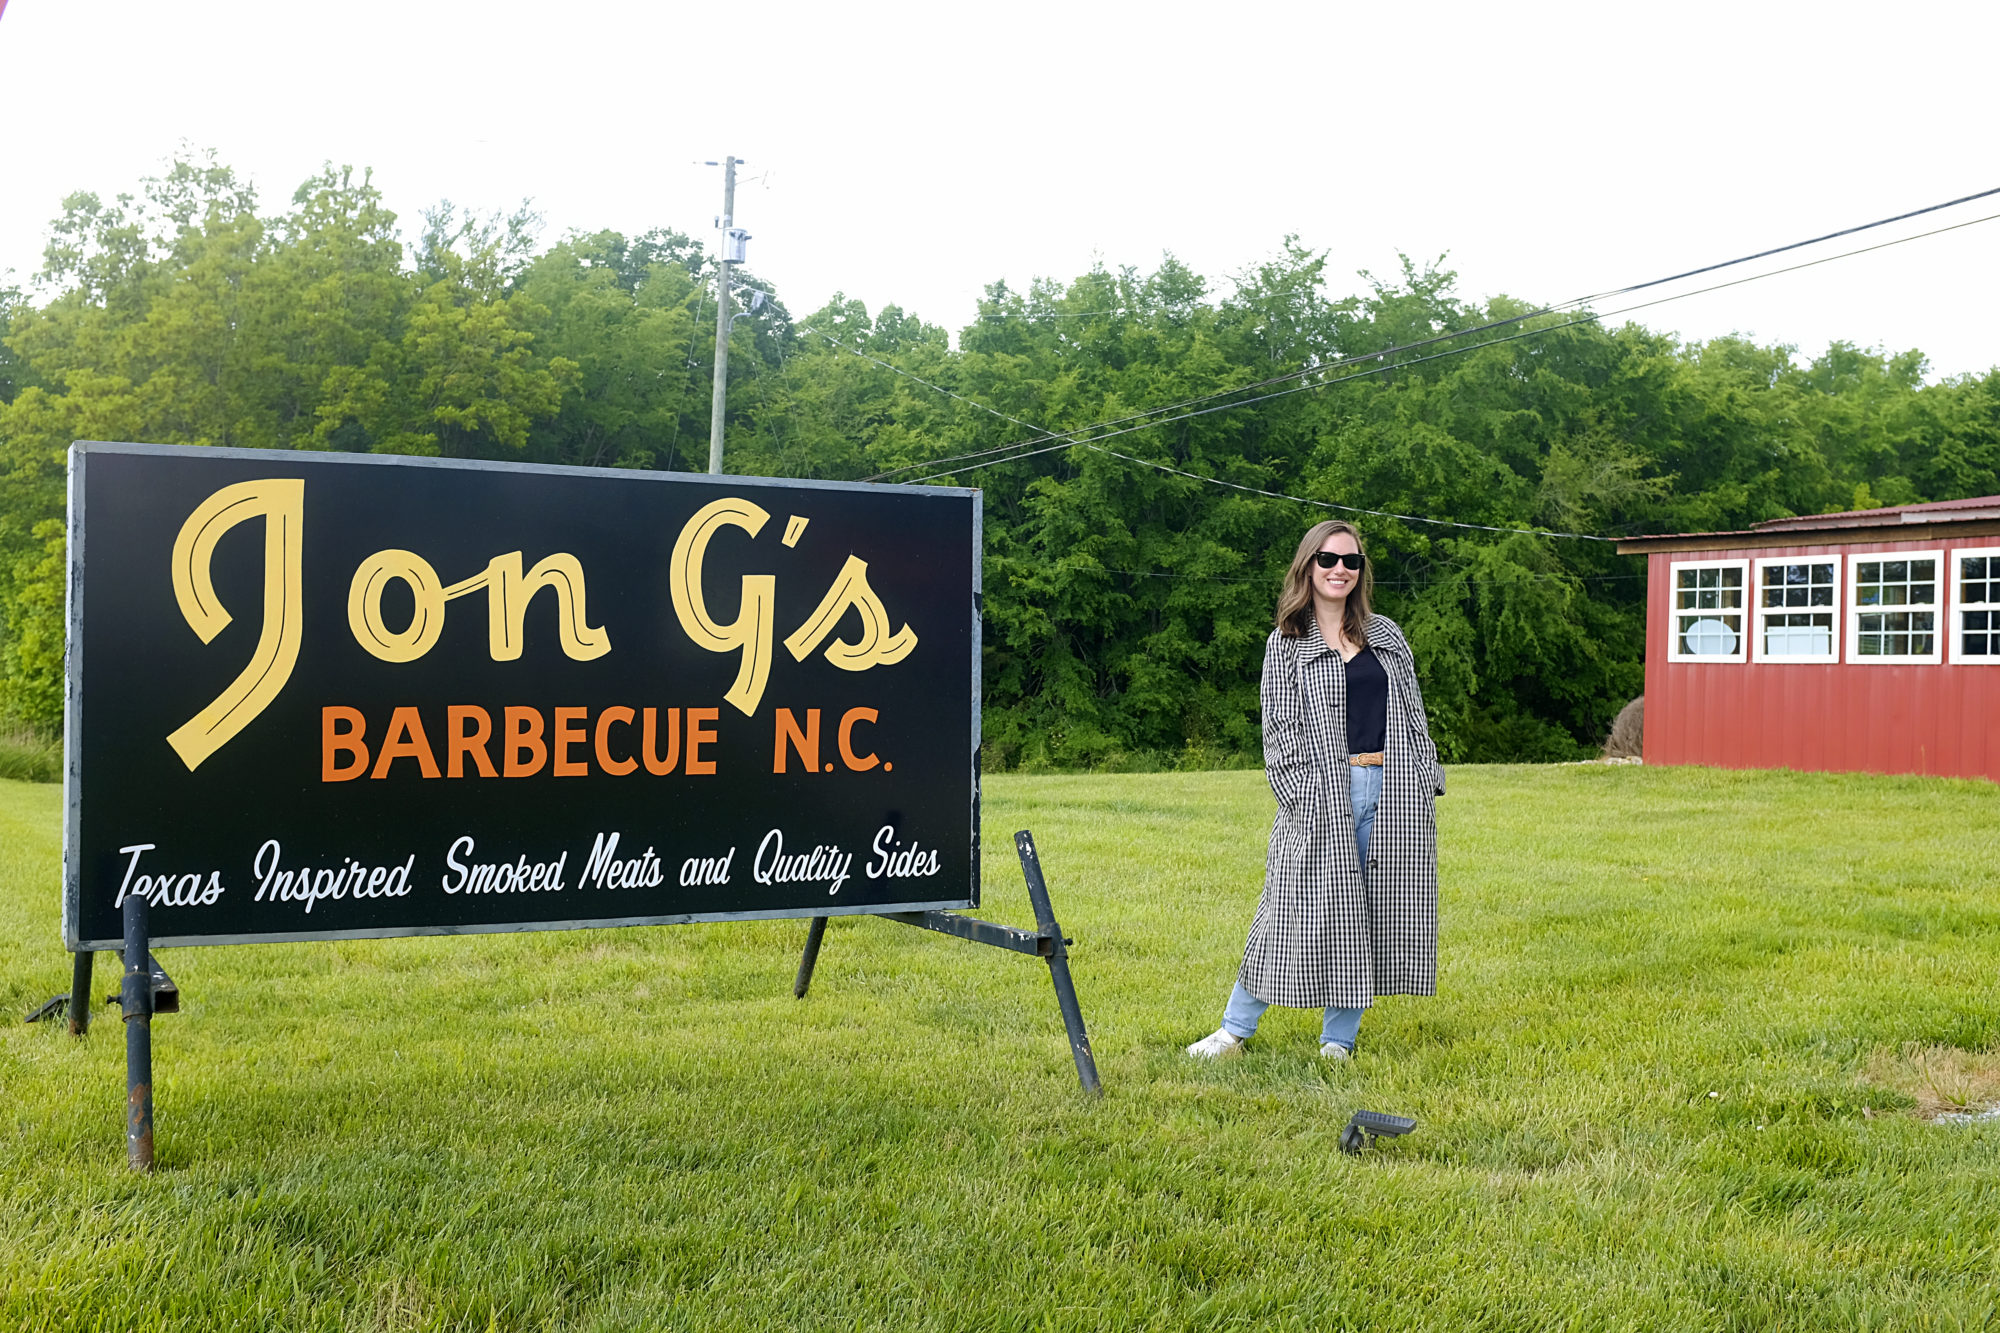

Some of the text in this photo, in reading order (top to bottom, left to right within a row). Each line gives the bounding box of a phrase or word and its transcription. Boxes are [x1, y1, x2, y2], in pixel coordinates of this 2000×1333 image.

[166, 478, 919, 772] Jon G's
[322, 704, 894, 782] BARBECUE N.C.
[253, 839, 415, 914] Inspired
[442, 835, 568, 895] Smoked
[578, 831, 665, 890] Meats
[679, 846, 736, 887] and
[753, 828, 853, 896] Quality
[865, 825, 941, 879] Sides
